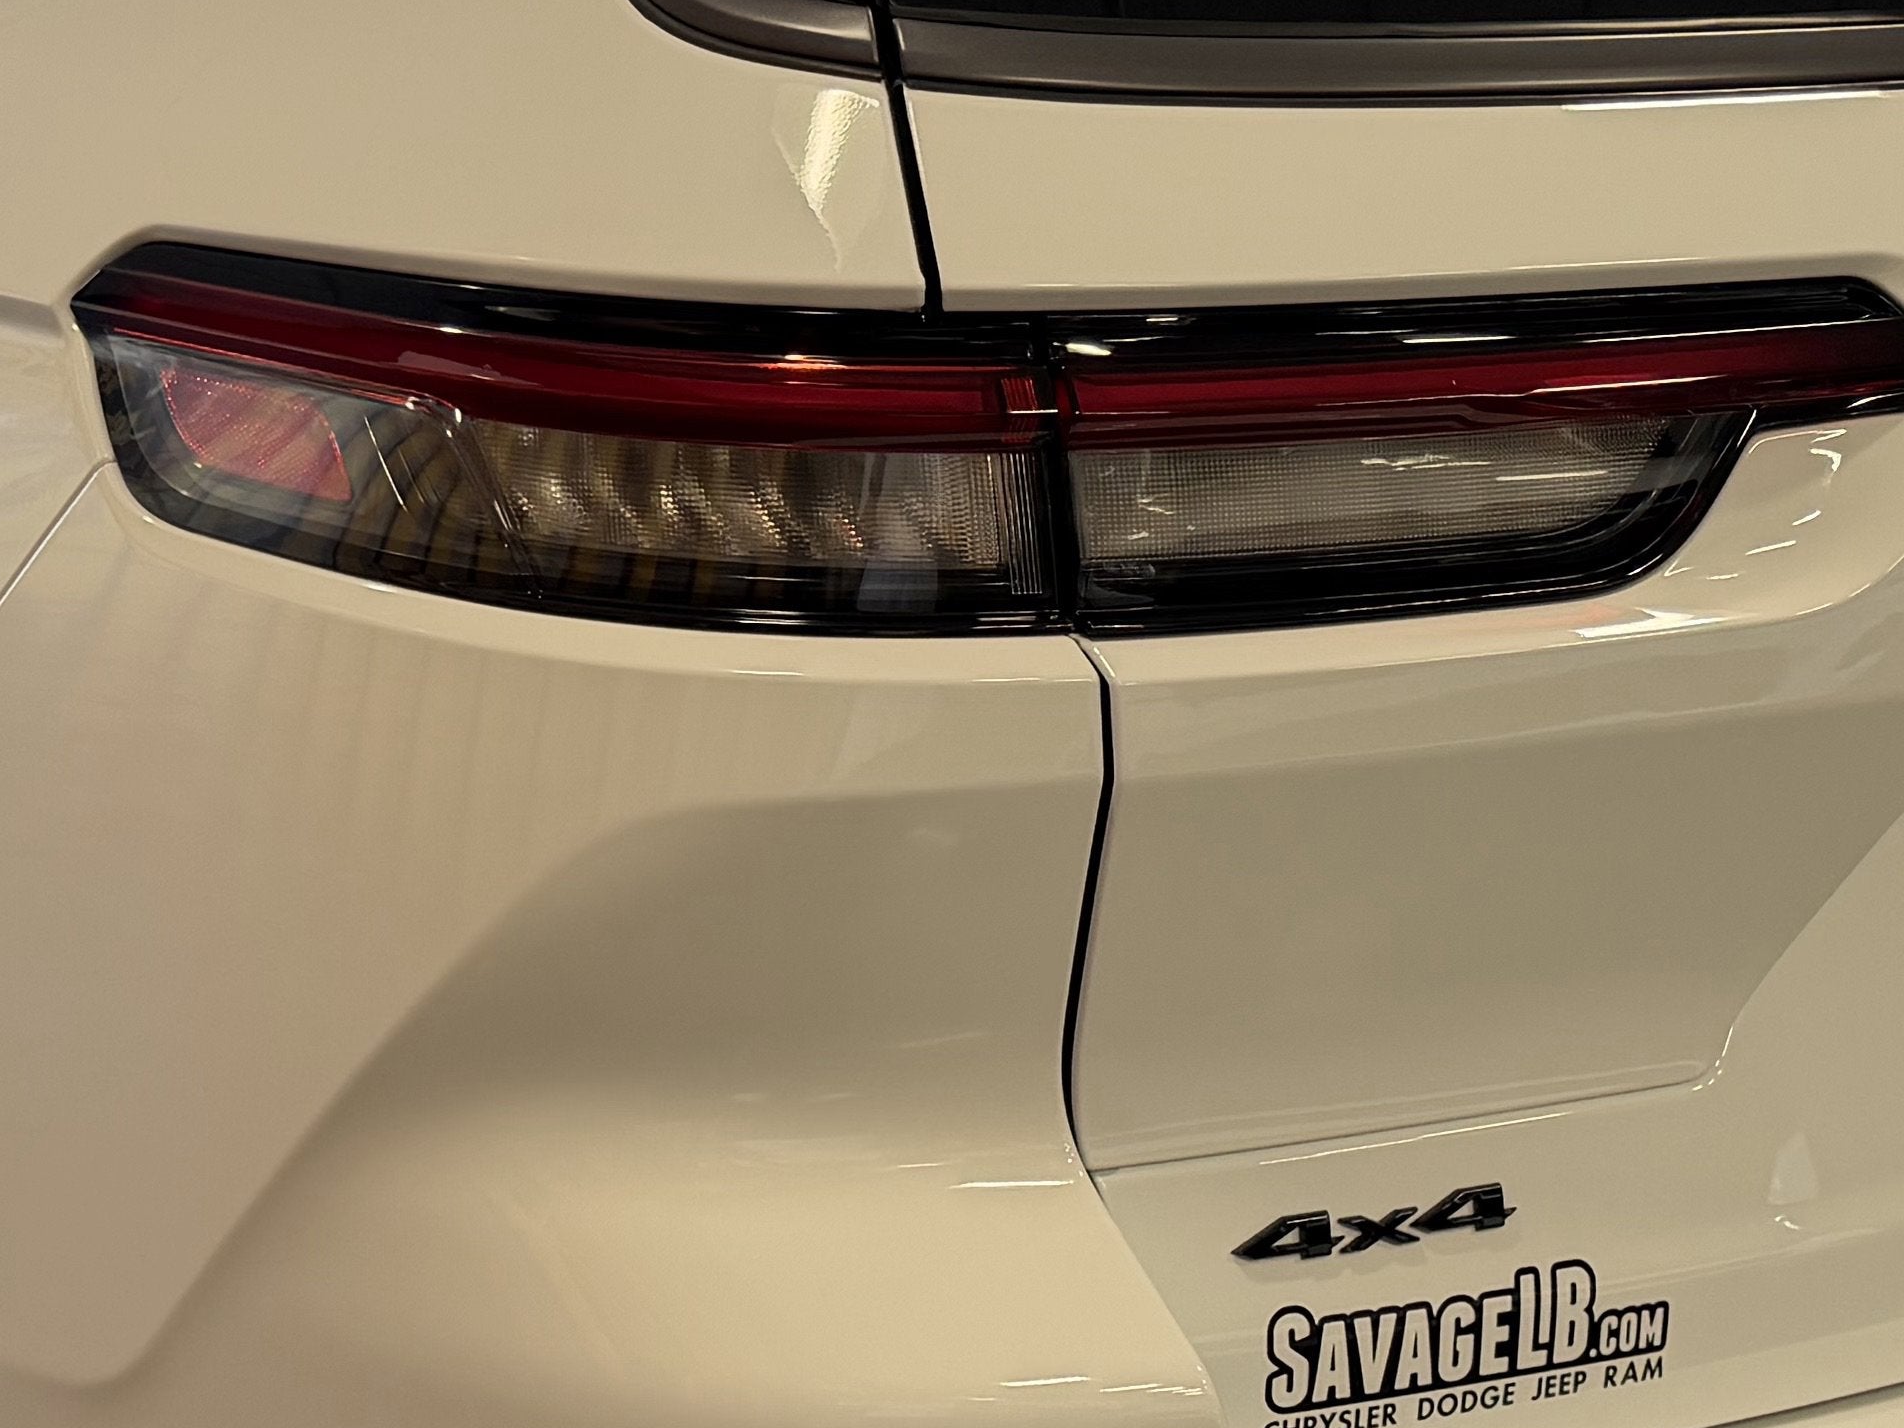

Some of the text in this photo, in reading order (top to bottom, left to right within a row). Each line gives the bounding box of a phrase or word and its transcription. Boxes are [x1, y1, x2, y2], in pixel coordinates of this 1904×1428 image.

[1231, 1182, 1517, 1260] 4x4
[1417, 1383, 1516, 1421] DODGE
[1531, 1371, 1588, 1401] JEEP
[1603, 1357, 1664, 1388] RAM
